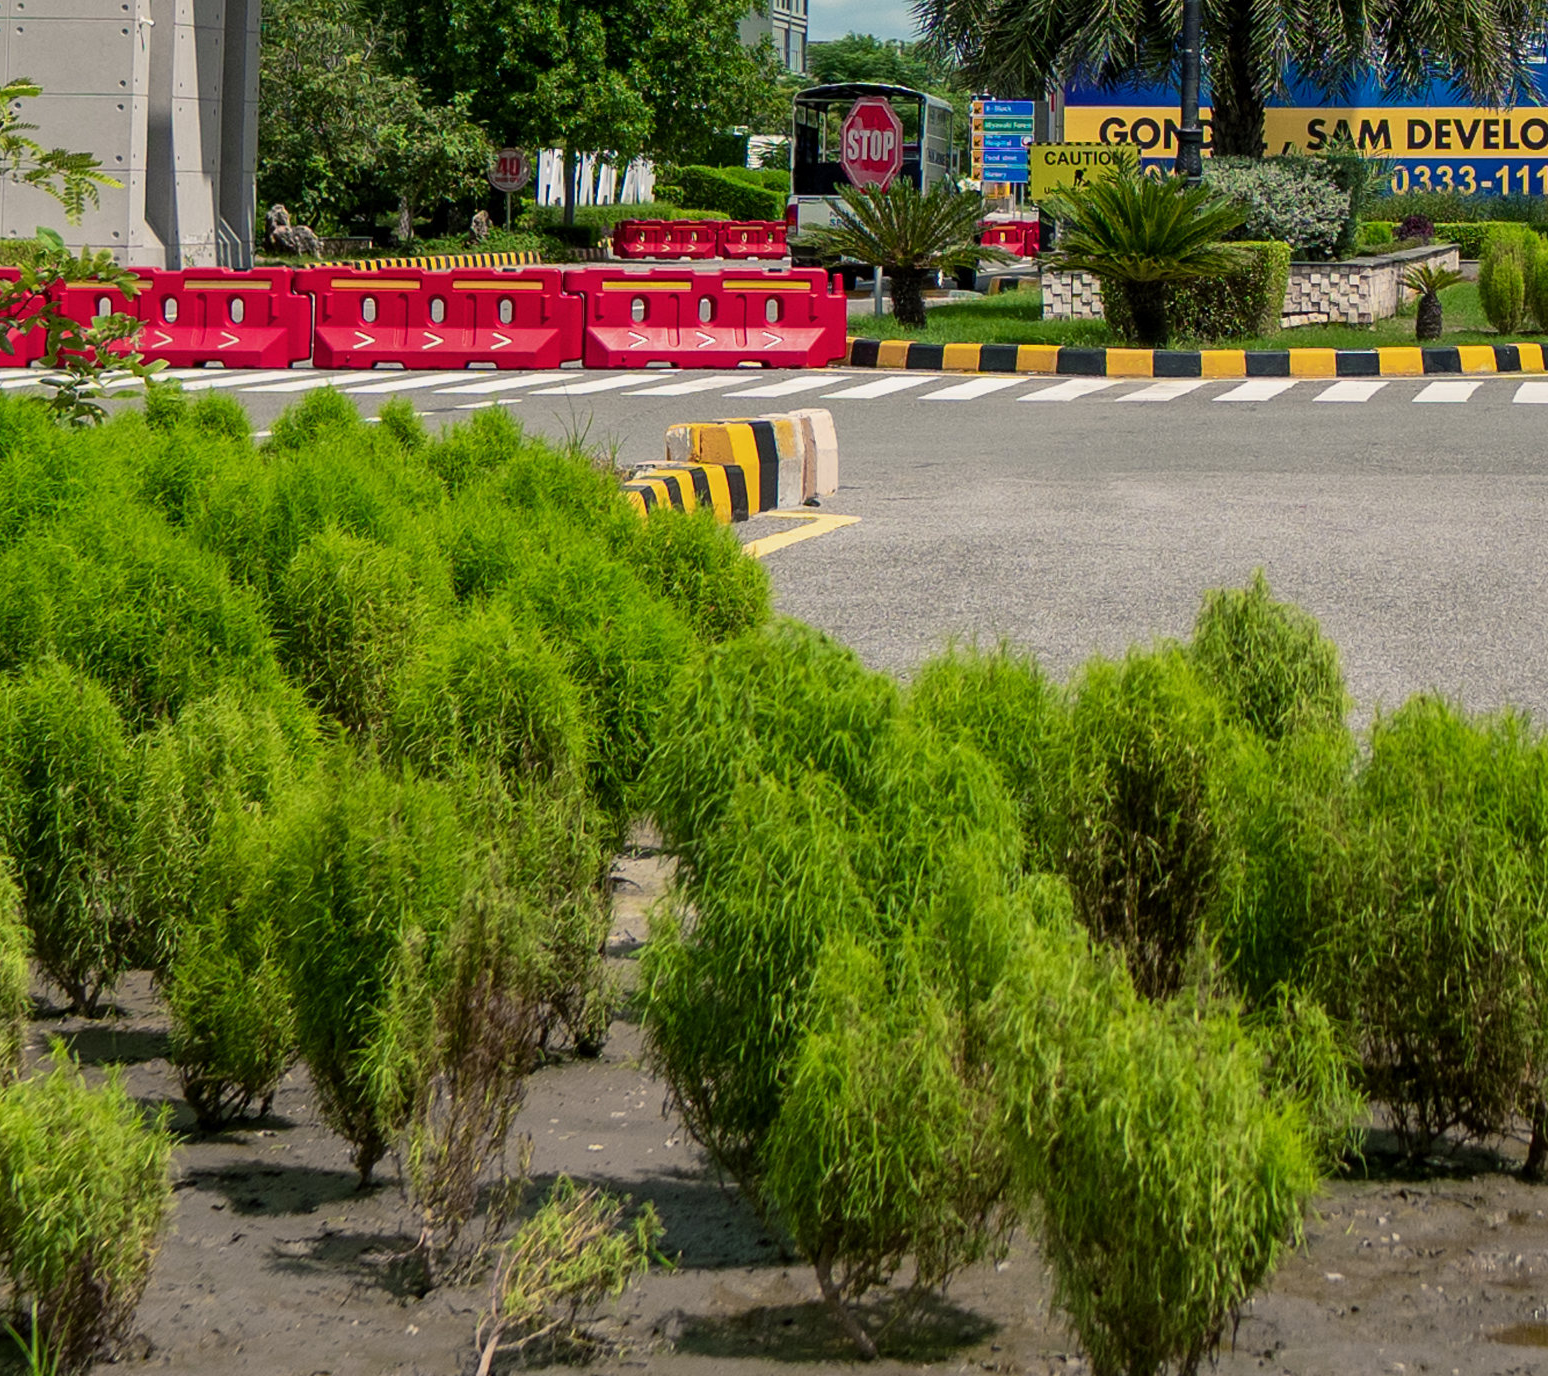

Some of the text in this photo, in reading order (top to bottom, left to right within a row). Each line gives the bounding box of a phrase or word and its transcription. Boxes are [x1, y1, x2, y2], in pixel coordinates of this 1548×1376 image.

[847, 128, 895, 162] STOP
[1305, 118, 1393, 151] SAM
[496, 157, 521, 176] 40
